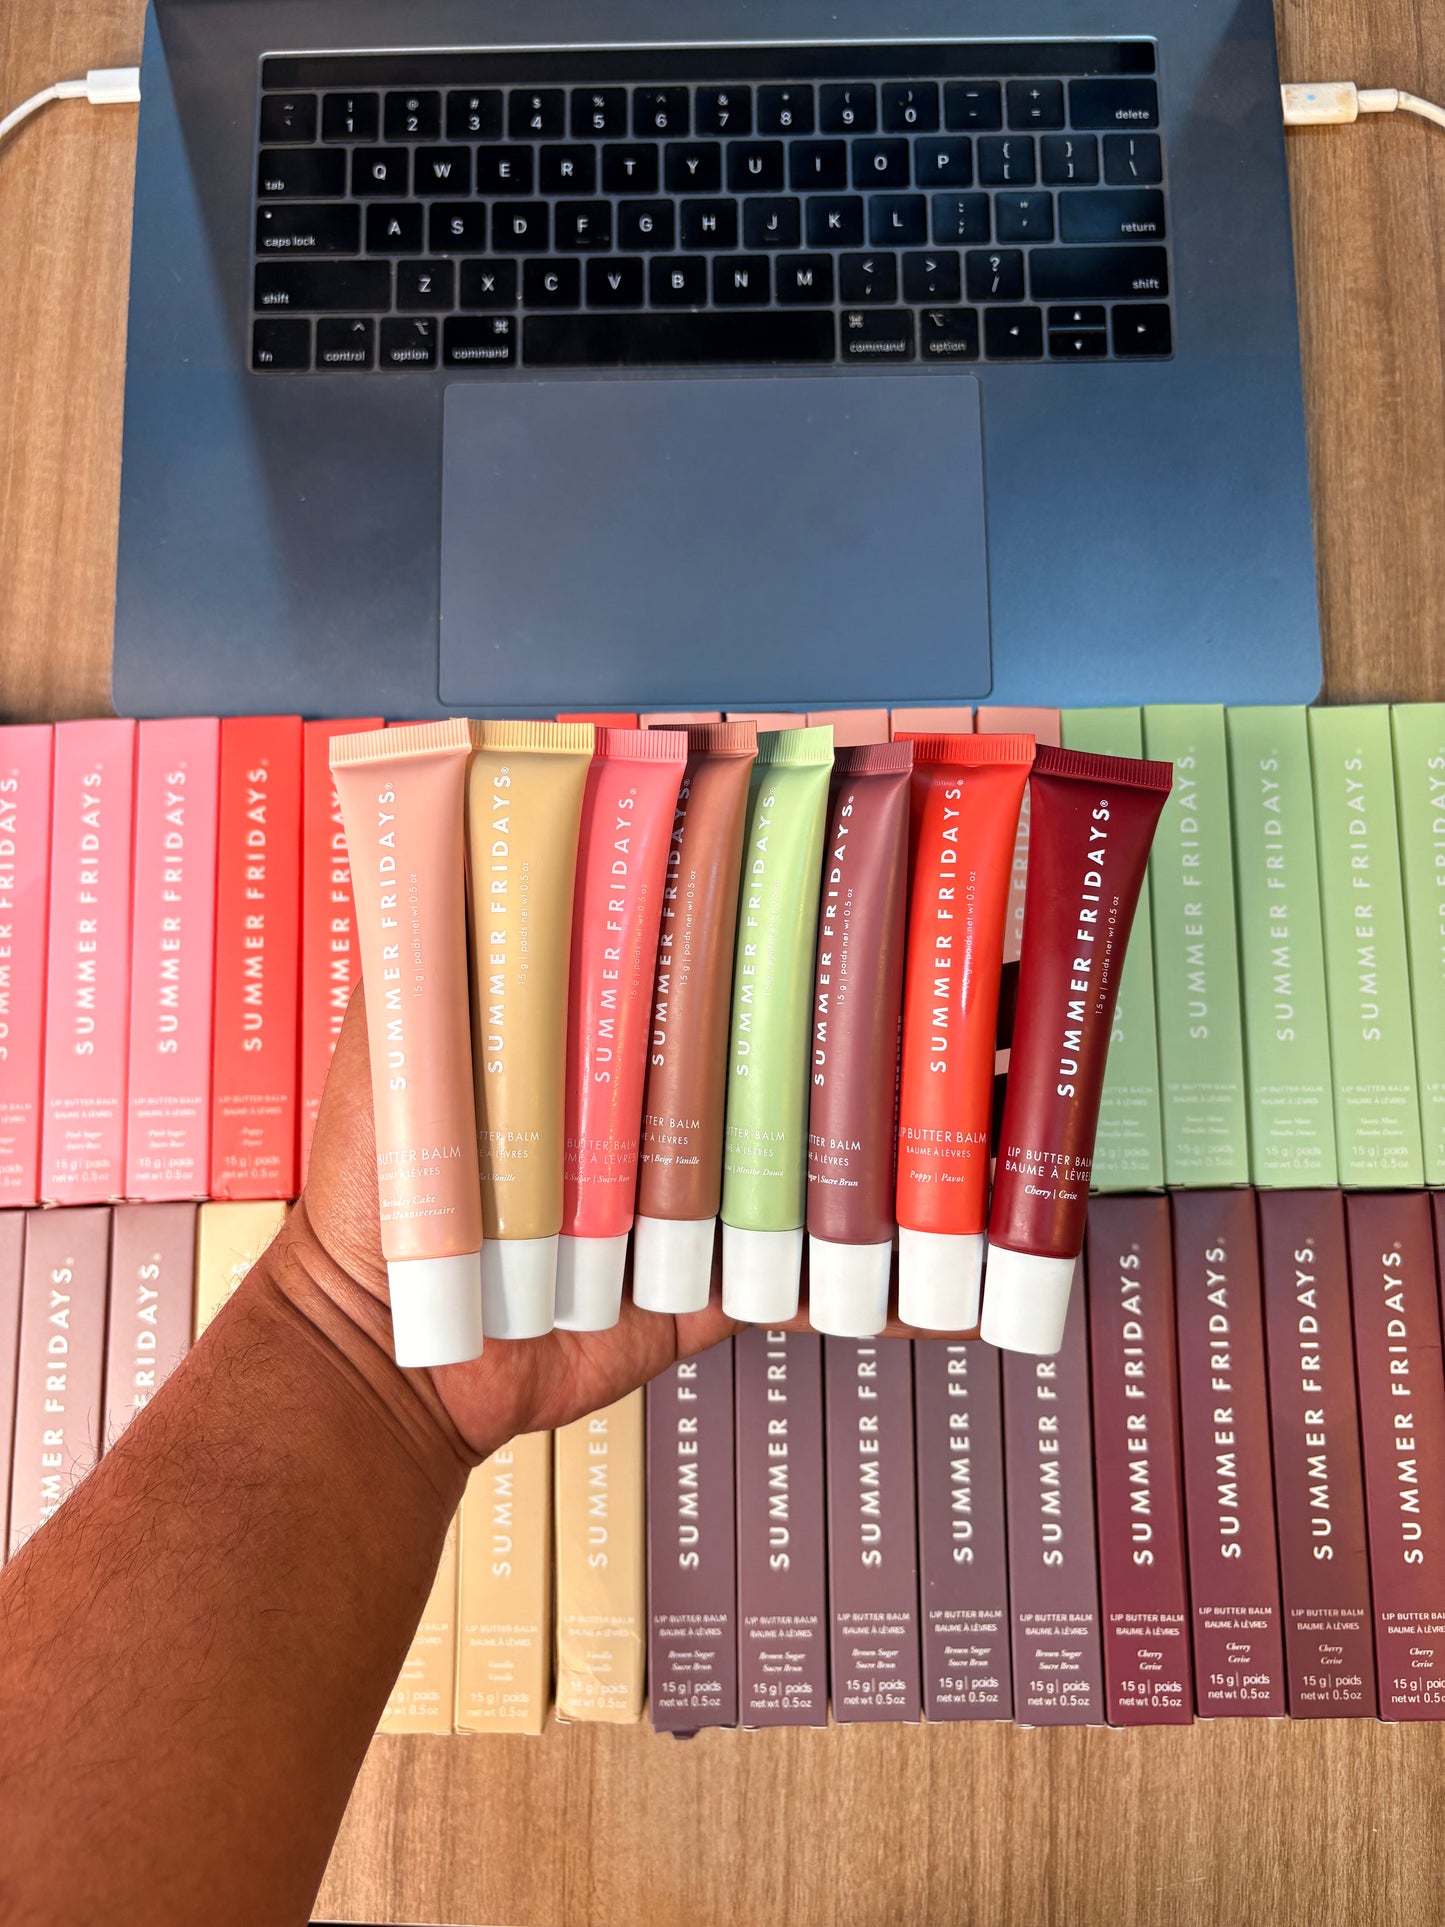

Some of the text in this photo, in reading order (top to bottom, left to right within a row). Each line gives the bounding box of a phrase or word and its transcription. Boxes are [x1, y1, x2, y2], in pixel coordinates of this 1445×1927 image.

[594, 115, 604, 128] 5
[656, 114, 667, 127] 6
[719, 113, 729, 126] 7
[781, 112, 792, 125] 8
[843, 110, 854, 124] 9
[905, 109, 916, 122] 0
[1116, 110, 1149, 119] delete
[347, 119, 353, 132] 1
[408, 118, 417, 131] 2
[469, 117, 480, 130] 3
[531, 116, 542, 129] 4
[624, 161, 635, 175] T
[687, 161, 698, 174] Y
[749, 160, 762, 173] U
[816, 158, 820, 171] I
[874, 156, 887, 170] O
[938, 155, 949, 168] P
[373, 165, 386, 180] Q
[434, 164, 451, 177] W
[500, 163, 510, 177] E
[561, 162, 573, 176] R
[266, 180, 284, 190] tab
[452, 220, 463, 234] S
[514, 219, 527, 233] D
[578, 219, 587, 232] F
[639, 218, 652, 232] G
[703, 217, 715, 230] H
[767, 215, 777, 230] J
[829, 214, 840, 228] K
[893, 213, 903, 227] L
[389, 221, 401, 235] A
[1121, 223, 1155, 232] return
[265, 236, 315, 248] caps lock
[482, 277, 494, 291] X
[545, 276, 557, 290] C
[608, 275, 621, 289] V
[672, 274, 684, 288] B
[735, 271, 748, 287] N
[797, 270, 812, 285] M
[1133, 279, 1159, 289] shift
[420, 278, 431, 292] Z
[263, 293, 289, 304] shift
[453, 348, 508, 359] command
[850, 341, 905, 352] command
[930, 341, 966, 353] option
[260, 352, 272, 361] fn
[325, 351, 365, 361] control
[392, 350, 428, 361] option
[1113, 896, 1119, 905] oz
[844, 920, 849, 929] wt
[848, 889, 853, 898] oz
[1108, 909, 1117, 923] 0.5
[1109, 927, 1113, 937] wt
[1185, 903, 1208, 1038] SUMMER
[1270, 906, 1295, 1040] SUMMER
[1355, 905, 1380, 1040] SUMMER
[76, 919, 97, 1054] SUMMER
[159, 918, 180, 1053] SUMMER
[244, 915, 264, 1051] SUMMER
[488, 930, 506, 1073] SUMMER
[652, 934, 675, 1066] SUMMER
[930, 936, 952, 1072] SUMMER
[595, 947, 622, 1084] SUMMER
[737, 944, 758, 1078] SUMMER
[1096, 1004, 1103, 1014] 15
[383, 944, 406, 1092] SUMMER
[815, 953, 831, 1086] SUMMER
[1057, 958, 1091, 1097] SUMMER
[669, 1118, 699, 1129] BALM
[650, 1132, 688, 1144] À LÈVRES
[754, 1128, 784, 1140] BALM
[908, 1128, 986, 1143] BUTTER BALM
[830, 1139, 860, 1150] BALM
[907, 1146, 970, 1157] BAUME À LÈVRES
[377, 1146, 460, 1166] BUTTER BALM
[655, 1153, 699, 1165] Beige Vanille
[814, 1152, 848, 1166] À LÈVRES
[1008, 1147, 1020, 1157] LIP
[1026, 1150, 1070, 1166] BUTTER
[910, 1170, 964, 1182] Poppy Pavot
[1006, 1160, 1045, 1176] BAUME
[1051, 1166, 1058, 1178] À
[820, 1176, 858, 1186] Sucre Brun
[1025, 1185, 1077, 1199] Cherry Cerise
[413, 1194, 436, 1205] Cake
[950, 1413, 973, 1562] SUMMER
[1127, 1415, 1153, 1565] SUMMER
[1214, 1408, 1241, 1558] SUMMER
[1305, 1409, 1333, 1559] SUMMER
[1394, 1414, 1423, 1563] SUMMER
[588, 1419, 608, 1567] SUMMER
[678, 1417, 699, 1567] SUMMER
[768, 1419, 789, 1569] SUMMER
[859, 1416, 881, 1565] SUMMER
[1039, 1416, 1063, 1565] SUMMER
[1234, 1619, 1240, 1628] À
[1241, 1620, 1267, 1628] LÈVRES
[1226, 1643, 1250, 1652] Cherry
[1211, 1674, 1270, 1687] 15 g poids
[1240, 1688, 1257, 1699] 0.5
